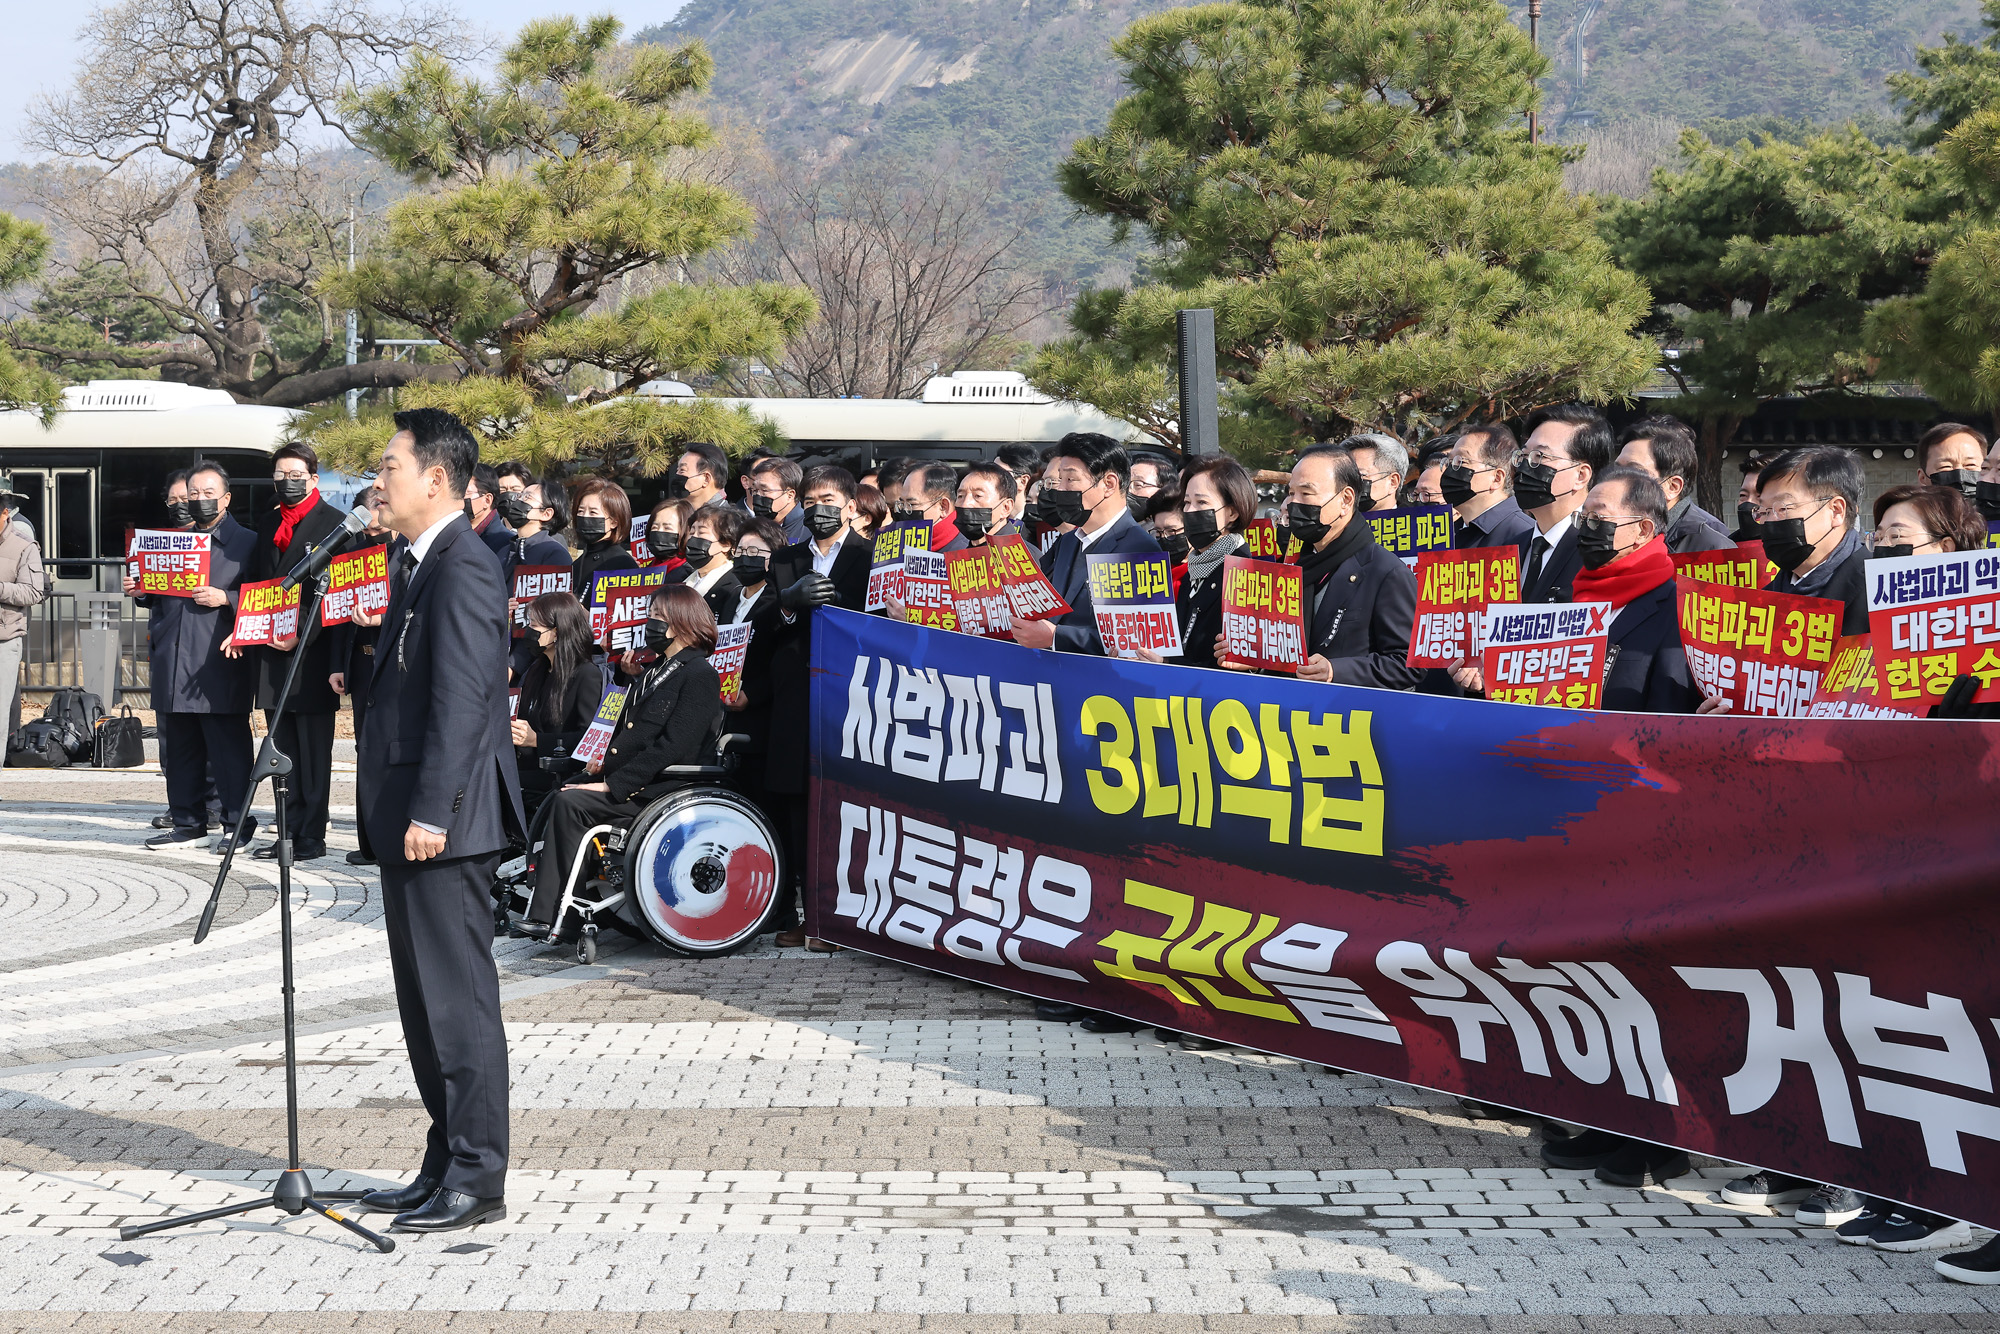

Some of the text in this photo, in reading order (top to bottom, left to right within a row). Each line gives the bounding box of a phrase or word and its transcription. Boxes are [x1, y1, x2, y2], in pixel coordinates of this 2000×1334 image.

[139, 535, 193, 550] 사법파괴 악법
[873, 528, 902, 564] 삼권분립
[1416, 511, 1451, 550] 파괴
[144, 553, 201, 572] 대한민국
[367, 551, 386, 579] 3법
[949, 555, 990, 594] 사법파괴
[1002, 542, 1038, 577] 3법
[1090, 559, 1170, 599] 삼권분립 파괴
[143, 573, 169, 591] 헌정
[1224, 566, 1300, 617] 사법파괴 3법
[1421, 556, 1518, 605] 사법파괴 3법
[1874, 561, 1969, 605] 사법파괴
[324, 588, 355, 620] 대통령은
[235, 614, 271, 641] 대통령은
[1097, 611, 1115, 649] 당장
[1116, 611, 1177, 651] 중단하라!
[1224, 611, 1257, 659] 대통령은
[1259, 618, 1304, 665] 거부하라!
[1414, 611, 1465, 660] 대통령은
[1489, 608, 1588, 643] 사법파괴 악법
[1682, 591, 1835, 663] 사법파괴 3법
[1496, 643, 1594, 684] 대한민국
[1885, 652, 1958, 700] 헌정
[841, 653, 1385, 857] 사법파괴 3대악법
[834, 799, 2000, 1176] 대통령은 국민을 위해 거부
